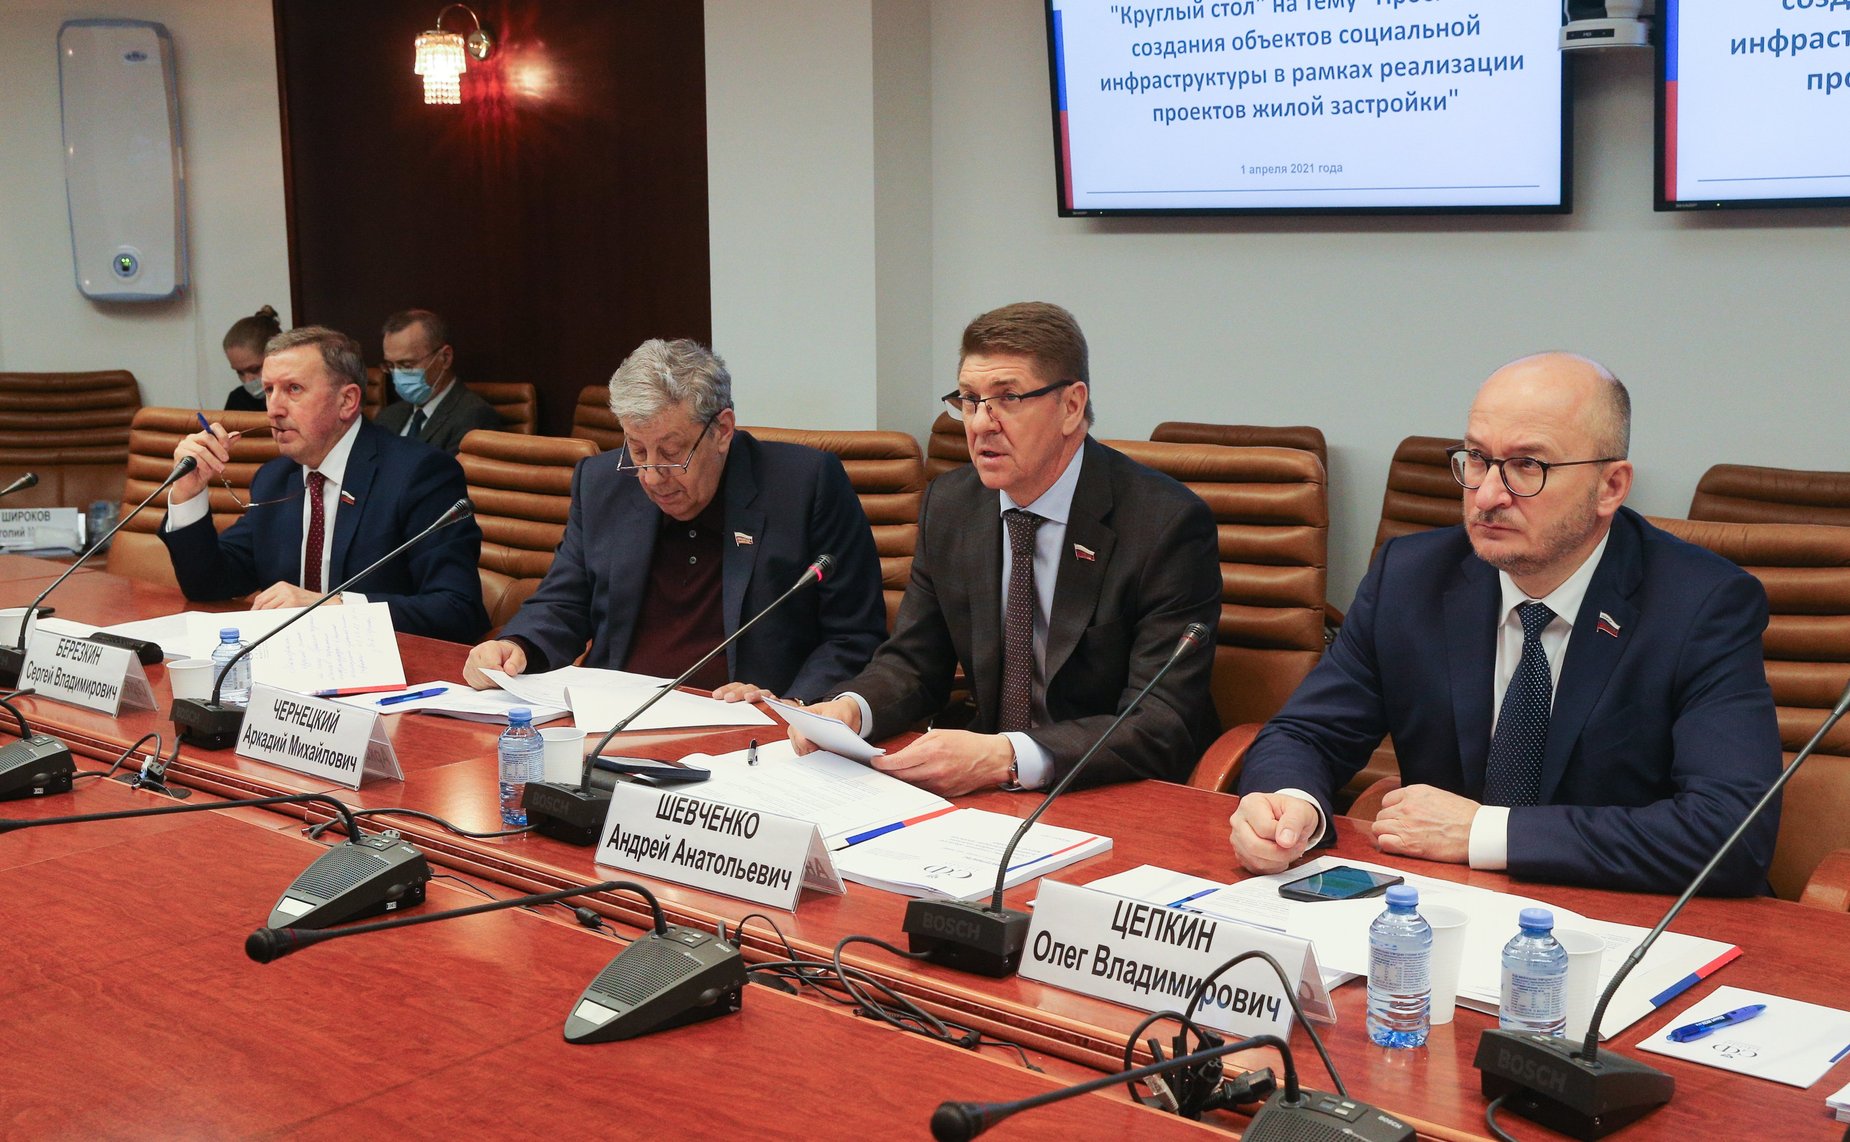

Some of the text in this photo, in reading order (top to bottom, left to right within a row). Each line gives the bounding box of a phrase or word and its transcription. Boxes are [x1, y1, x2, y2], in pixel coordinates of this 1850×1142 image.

[1111, 0, 1204, 28] "Круглый
[1211, 0, 1264, 18] стол
[1273, 0, 1297, 12] на
[1132, 13, 1480, 59] создания объектов социальной
[1100, 54, 1524, 94] инфраструктуры в рамках реализации
[1153, 88, 1459, 126] проектов жилой застройки"
[1240, 163, 1343, 177] 1 апреля 2021 года
[2, 511, 50, 522] ШИРОКОВ
[56, 638, 104, 665] БЕРЕЗКИН
[26, 660, 54, 686] Сергей
[54, 667, 118, 701] Владимирович
[273, 698, 341, 734] ЧЕРНЕЦКИЙ
[243, 723, 287, 753] Аркадий
[288, 735, 358, 773] Михайлович
[655, 793, 760, 840] ШЕВЧЕНКО
[606, 823, 672, 862] Андрей
[671, 838, 792, 891] Анатольевич
[922, 911, 981, 941] BOSCH
[1111, 899, 1218, 953] ЦЕПКИН
[1033, 930, 1282, 1022] Олег Владимирович
[1497, 1047, 1569, 1094] BOSCH
